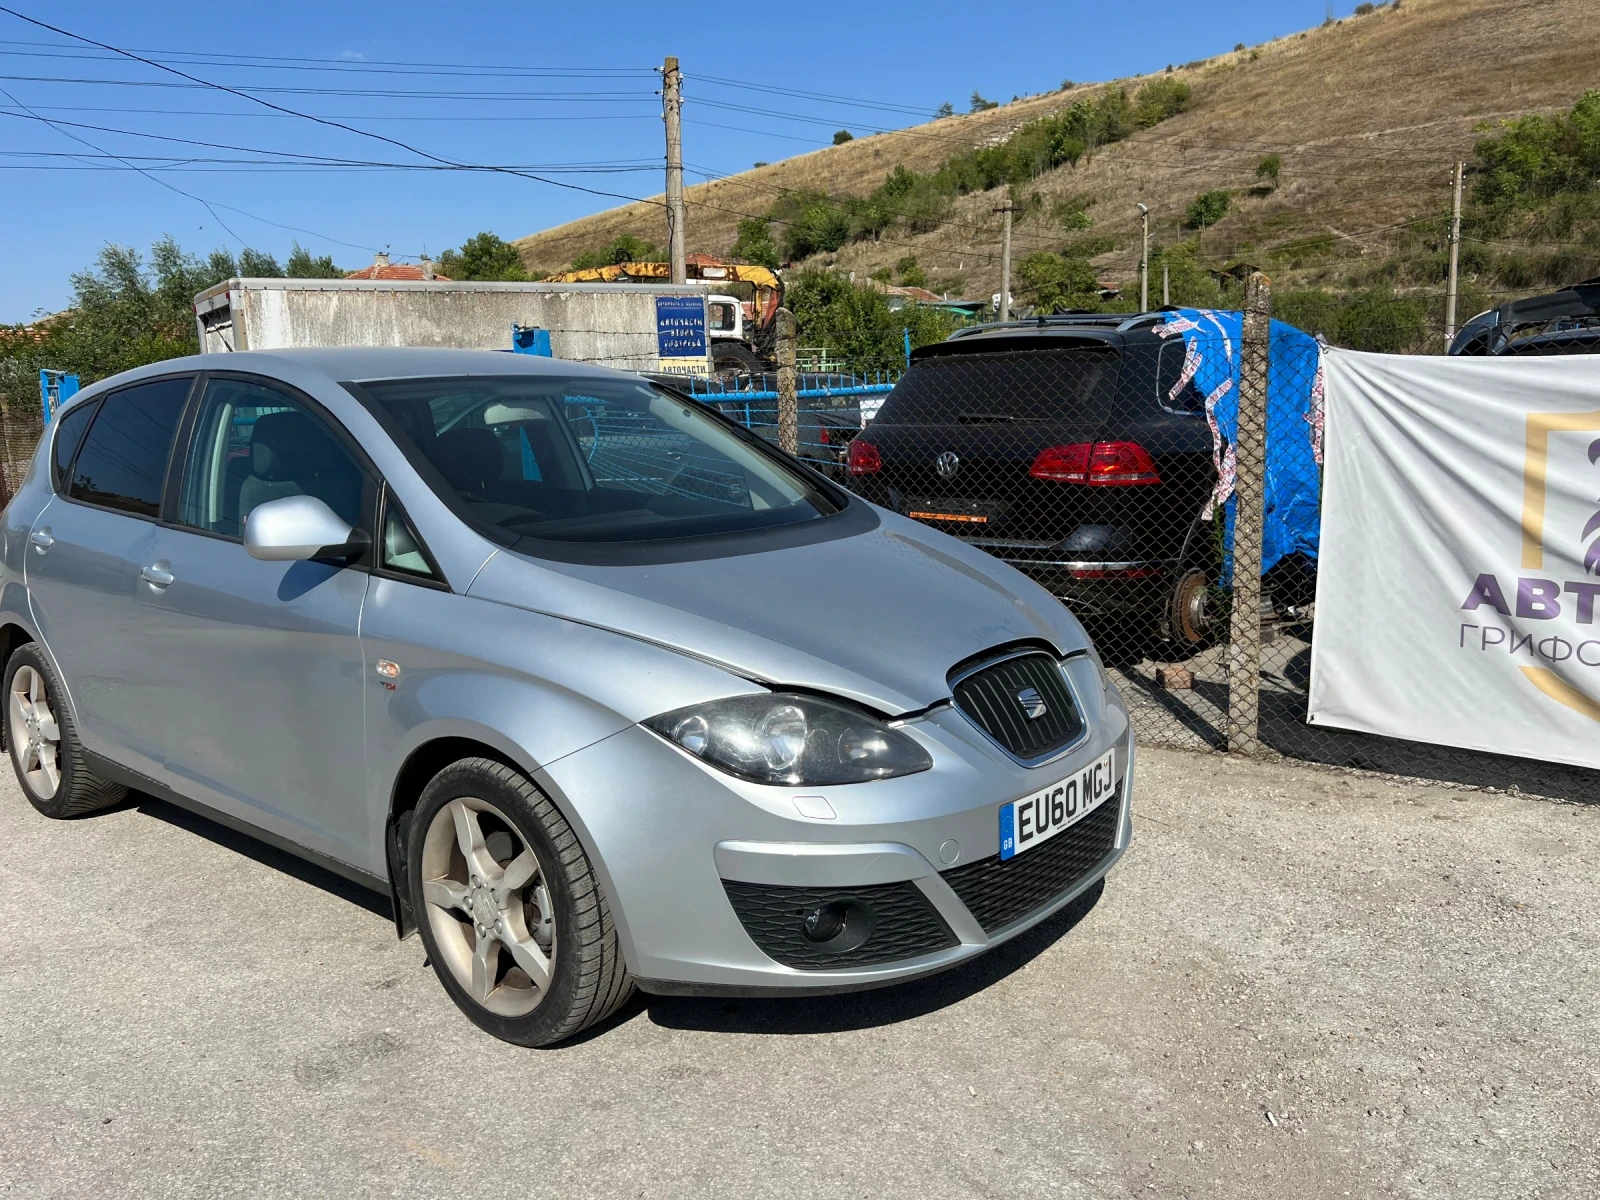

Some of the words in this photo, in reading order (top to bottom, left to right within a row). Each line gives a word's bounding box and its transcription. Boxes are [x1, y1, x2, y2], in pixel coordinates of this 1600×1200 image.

[663, 365, 706, 375] АВТОЧАСТИ
[1018, 779, 1077, 844] EU60
[1082, 754, 1112, 809] MGJ
[1003, 837, 1013, 850] GB
